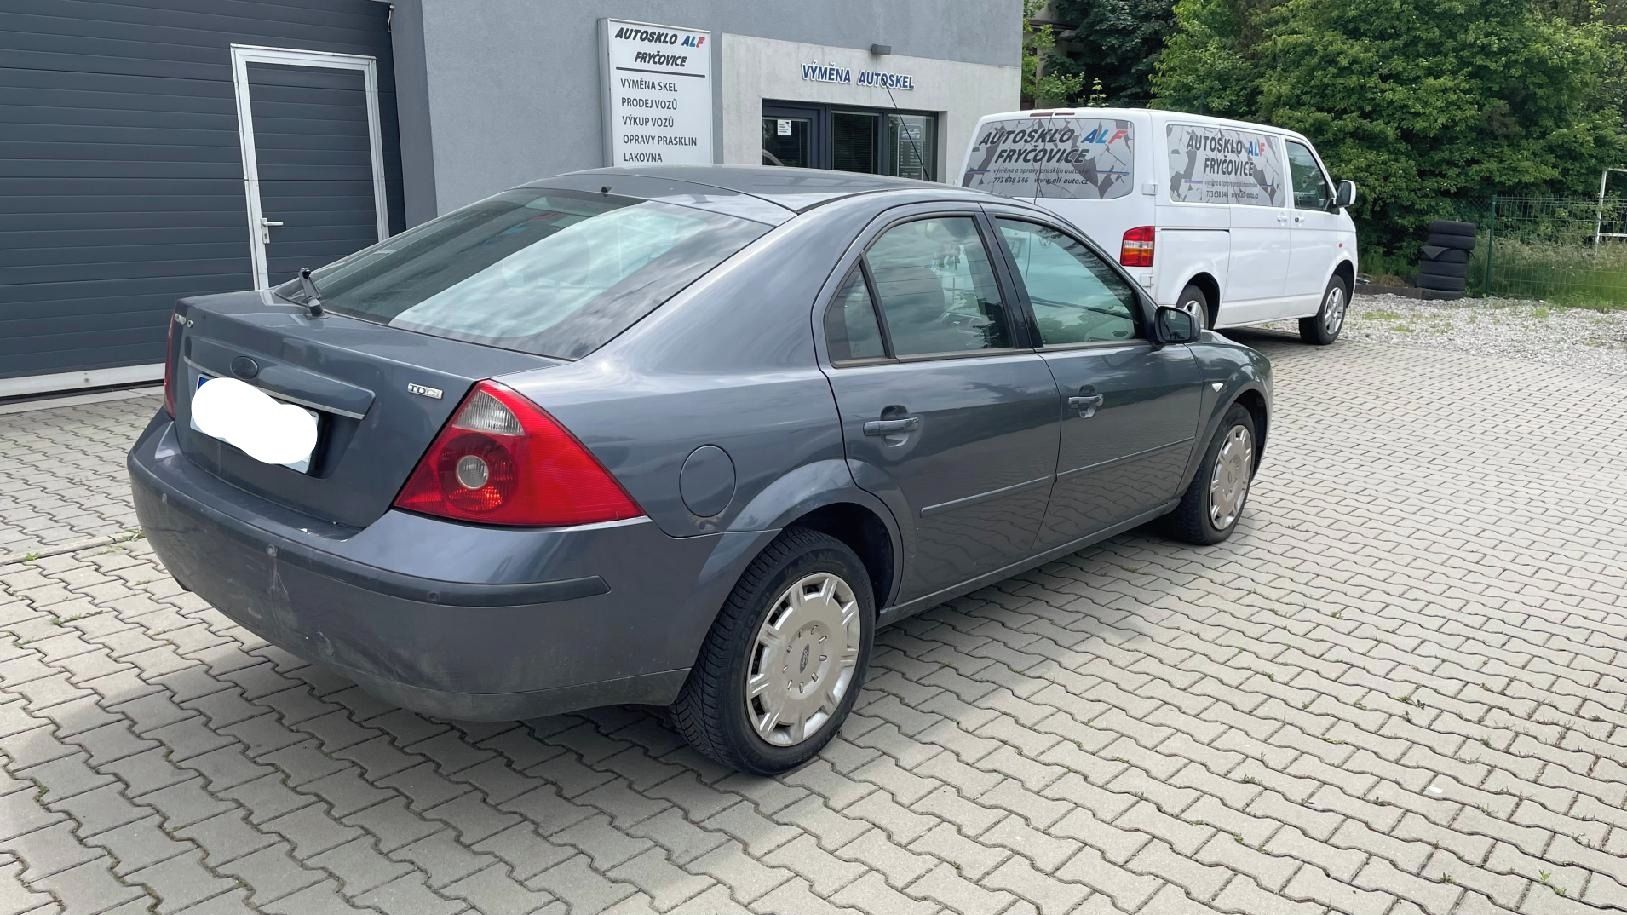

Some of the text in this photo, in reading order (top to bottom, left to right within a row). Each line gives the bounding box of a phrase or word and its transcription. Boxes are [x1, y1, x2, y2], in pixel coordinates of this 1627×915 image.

[615, 27, 705, 48] AUTOSKLO ALF
[802, 60, 915, 89] VÝMĚNA AUTOSKEL
[620, 77, 678, 92] VÝMĚNA SKEL
[621, 97, 654, 109] PRODEJ
[622, 114, 650, 126] VÝKUP
[623, 134, 697, 147] OPRAVY PRASKLIN
[979, 128, 1128, 146] AUTOSKLO ALF
[1187, 134, 1265, 157] AUTOSKLO ALF
[623, 152, 663, 163] LAKOVNA
[994, 144, 1090, 164] FRYČOVICE
[1203, 155, 1254, 177] FRYČOVICE
